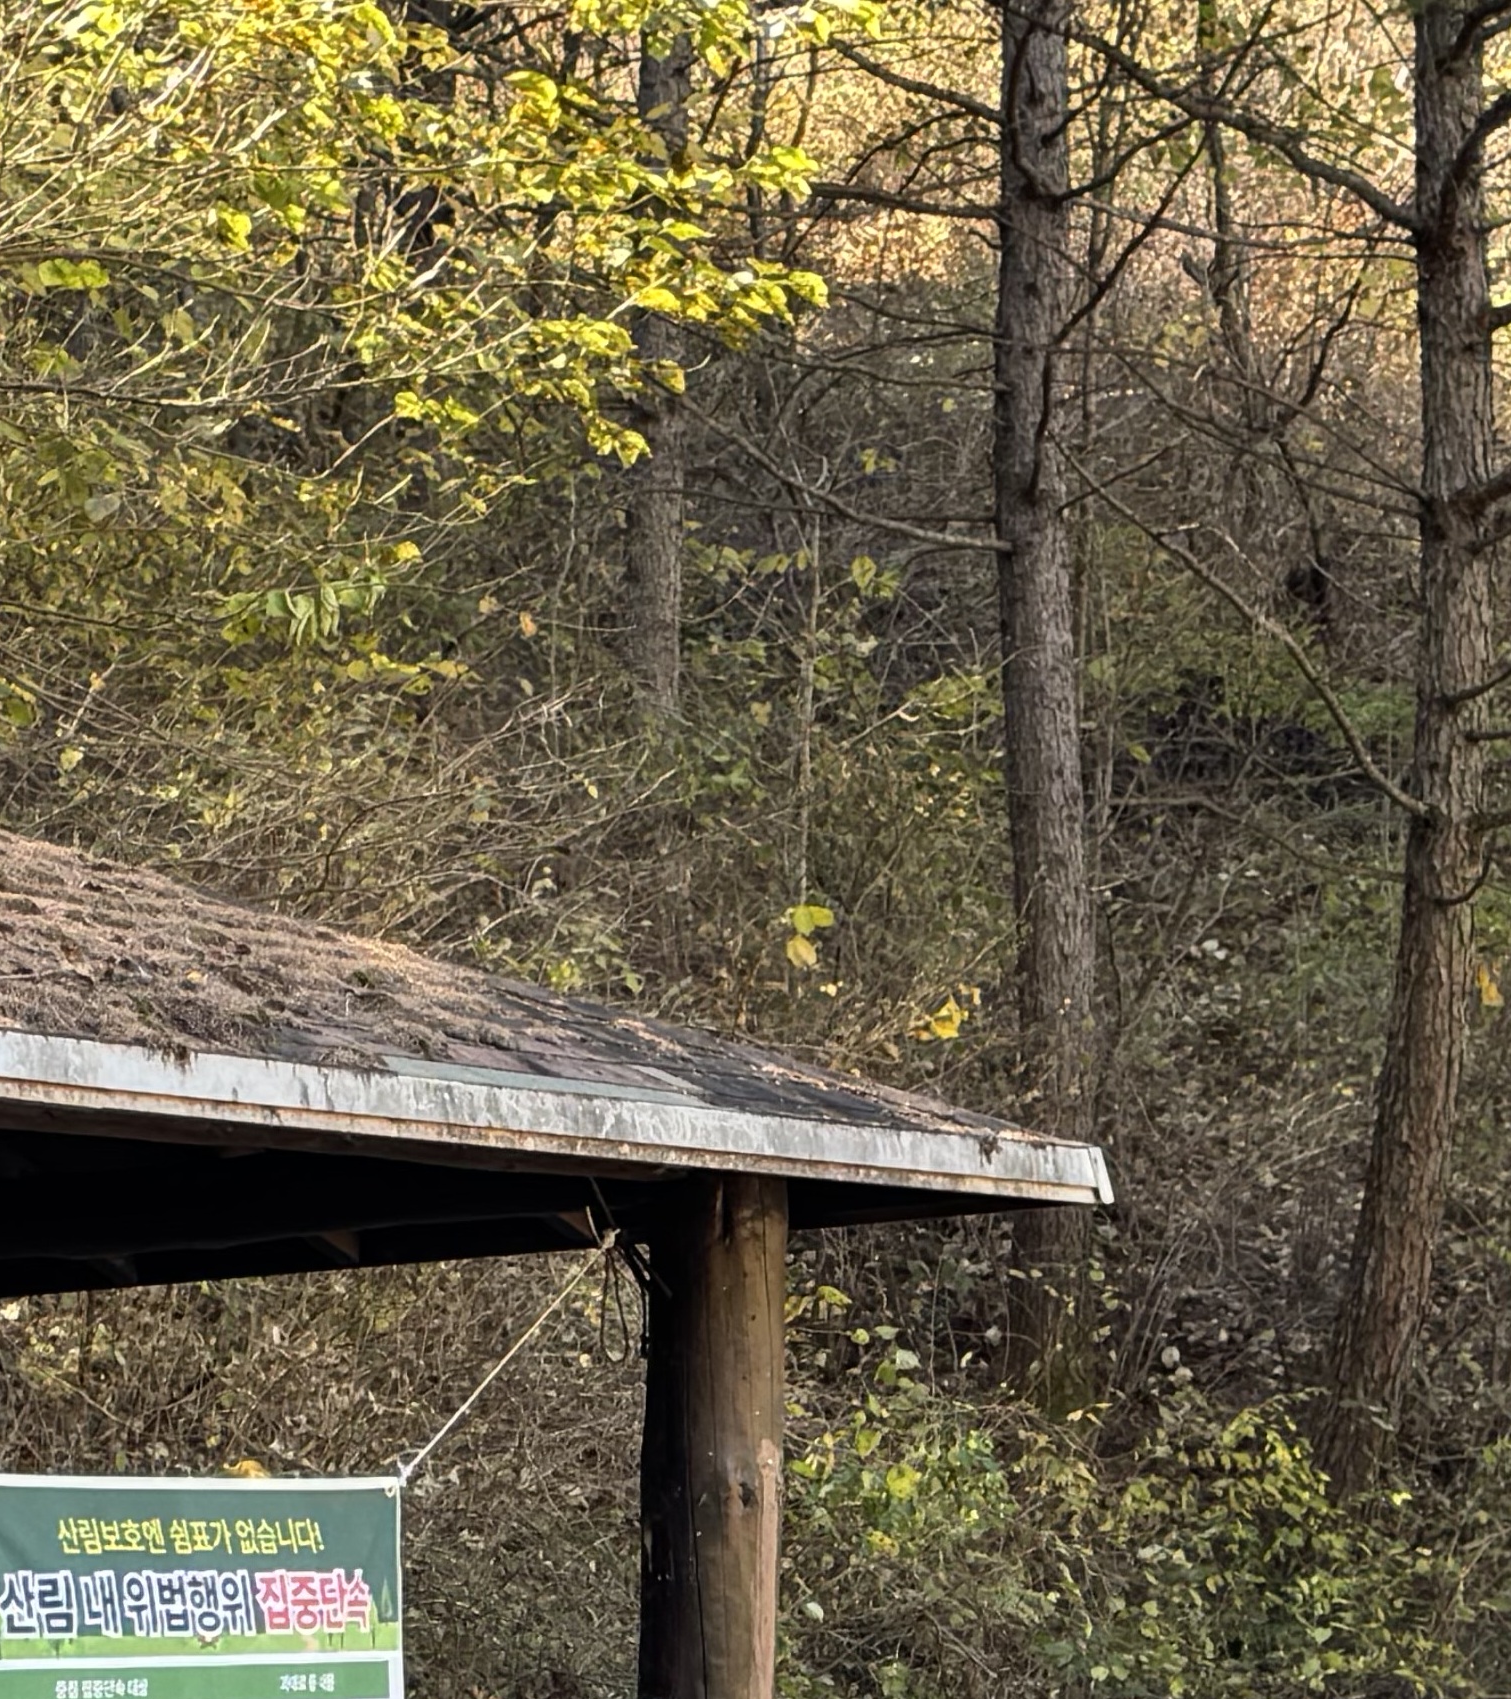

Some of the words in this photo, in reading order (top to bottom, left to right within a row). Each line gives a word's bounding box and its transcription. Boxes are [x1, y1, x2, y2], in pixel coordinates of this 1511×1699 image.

[58, 1518, 165, 1555] 산림보호엔
[169, 1518, 233, 1555] 쉼표가
[236, 1517, 325, 1555] 없습니다!
[80, 1571, 121, 1638] 내
[123, 1569, 256, 1637] 위법행위
[256, 1568, 372, 1634] 집중단속
